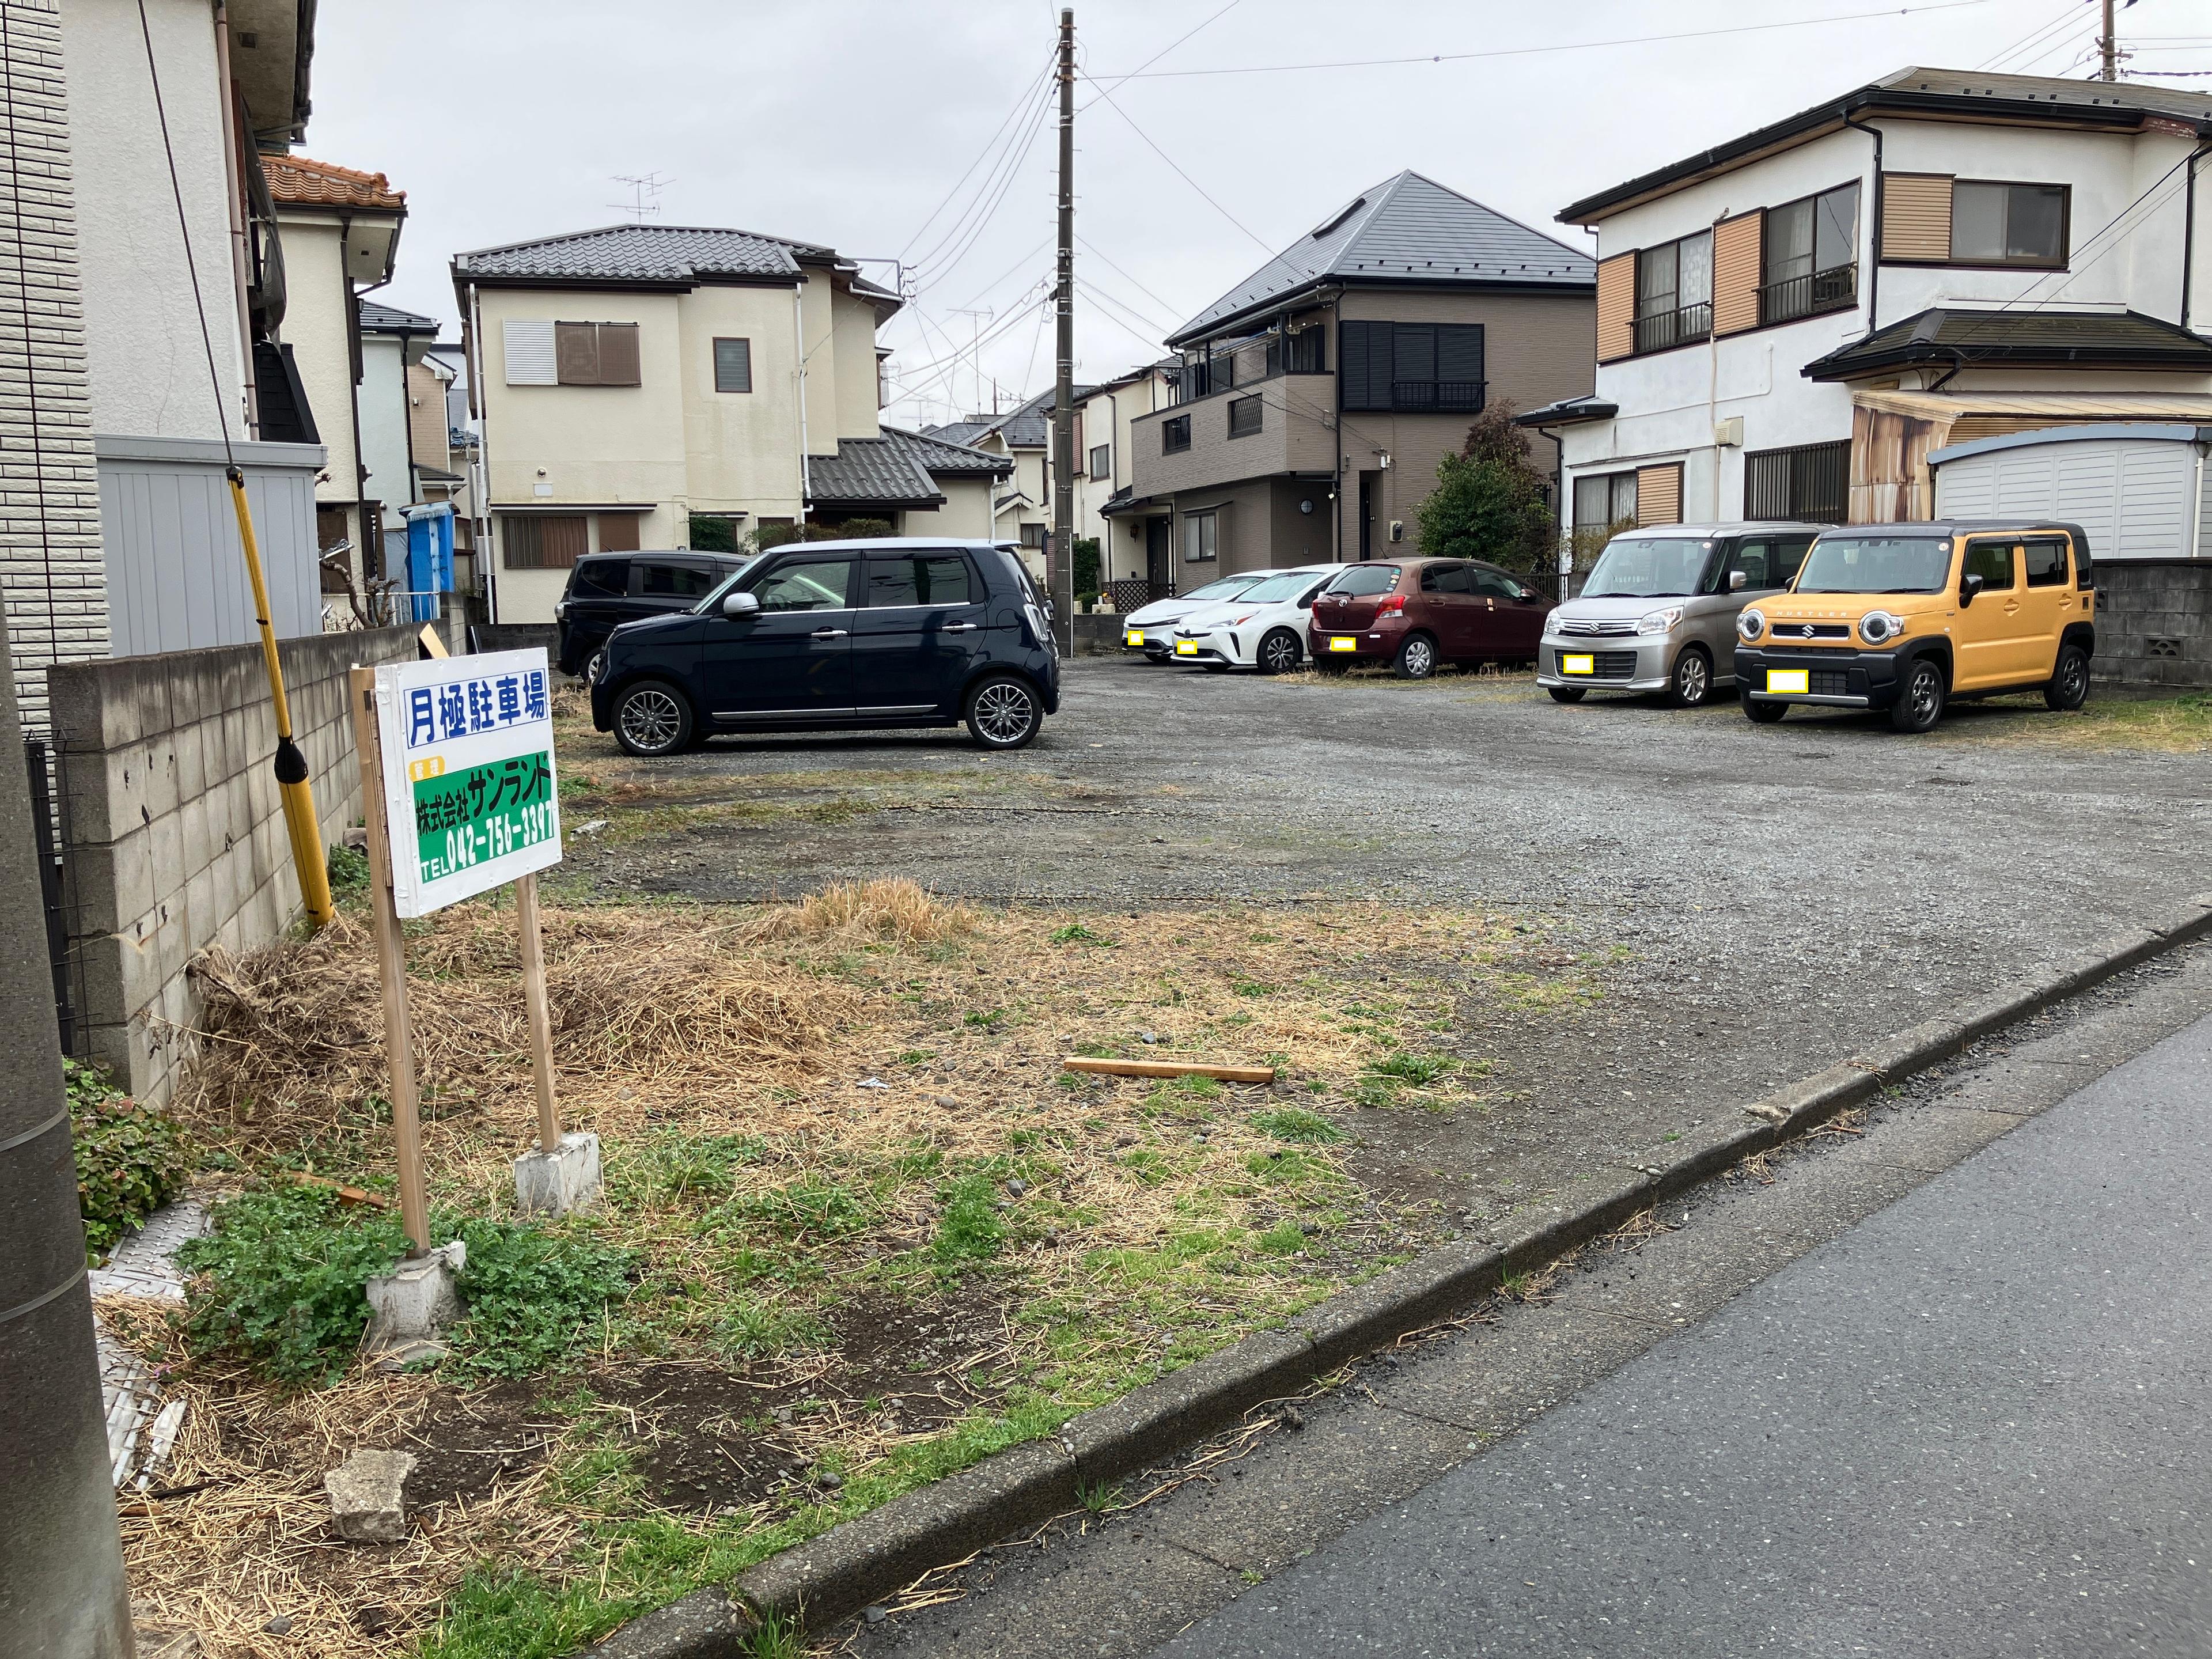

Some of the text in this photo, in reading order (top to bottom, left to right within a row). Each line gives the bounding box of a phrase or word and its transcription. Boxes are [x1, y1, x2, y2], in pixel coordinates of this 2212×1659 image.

[411, 671, 545, 746] 月極駐車場
[414, 759, 440, 780] 管理
